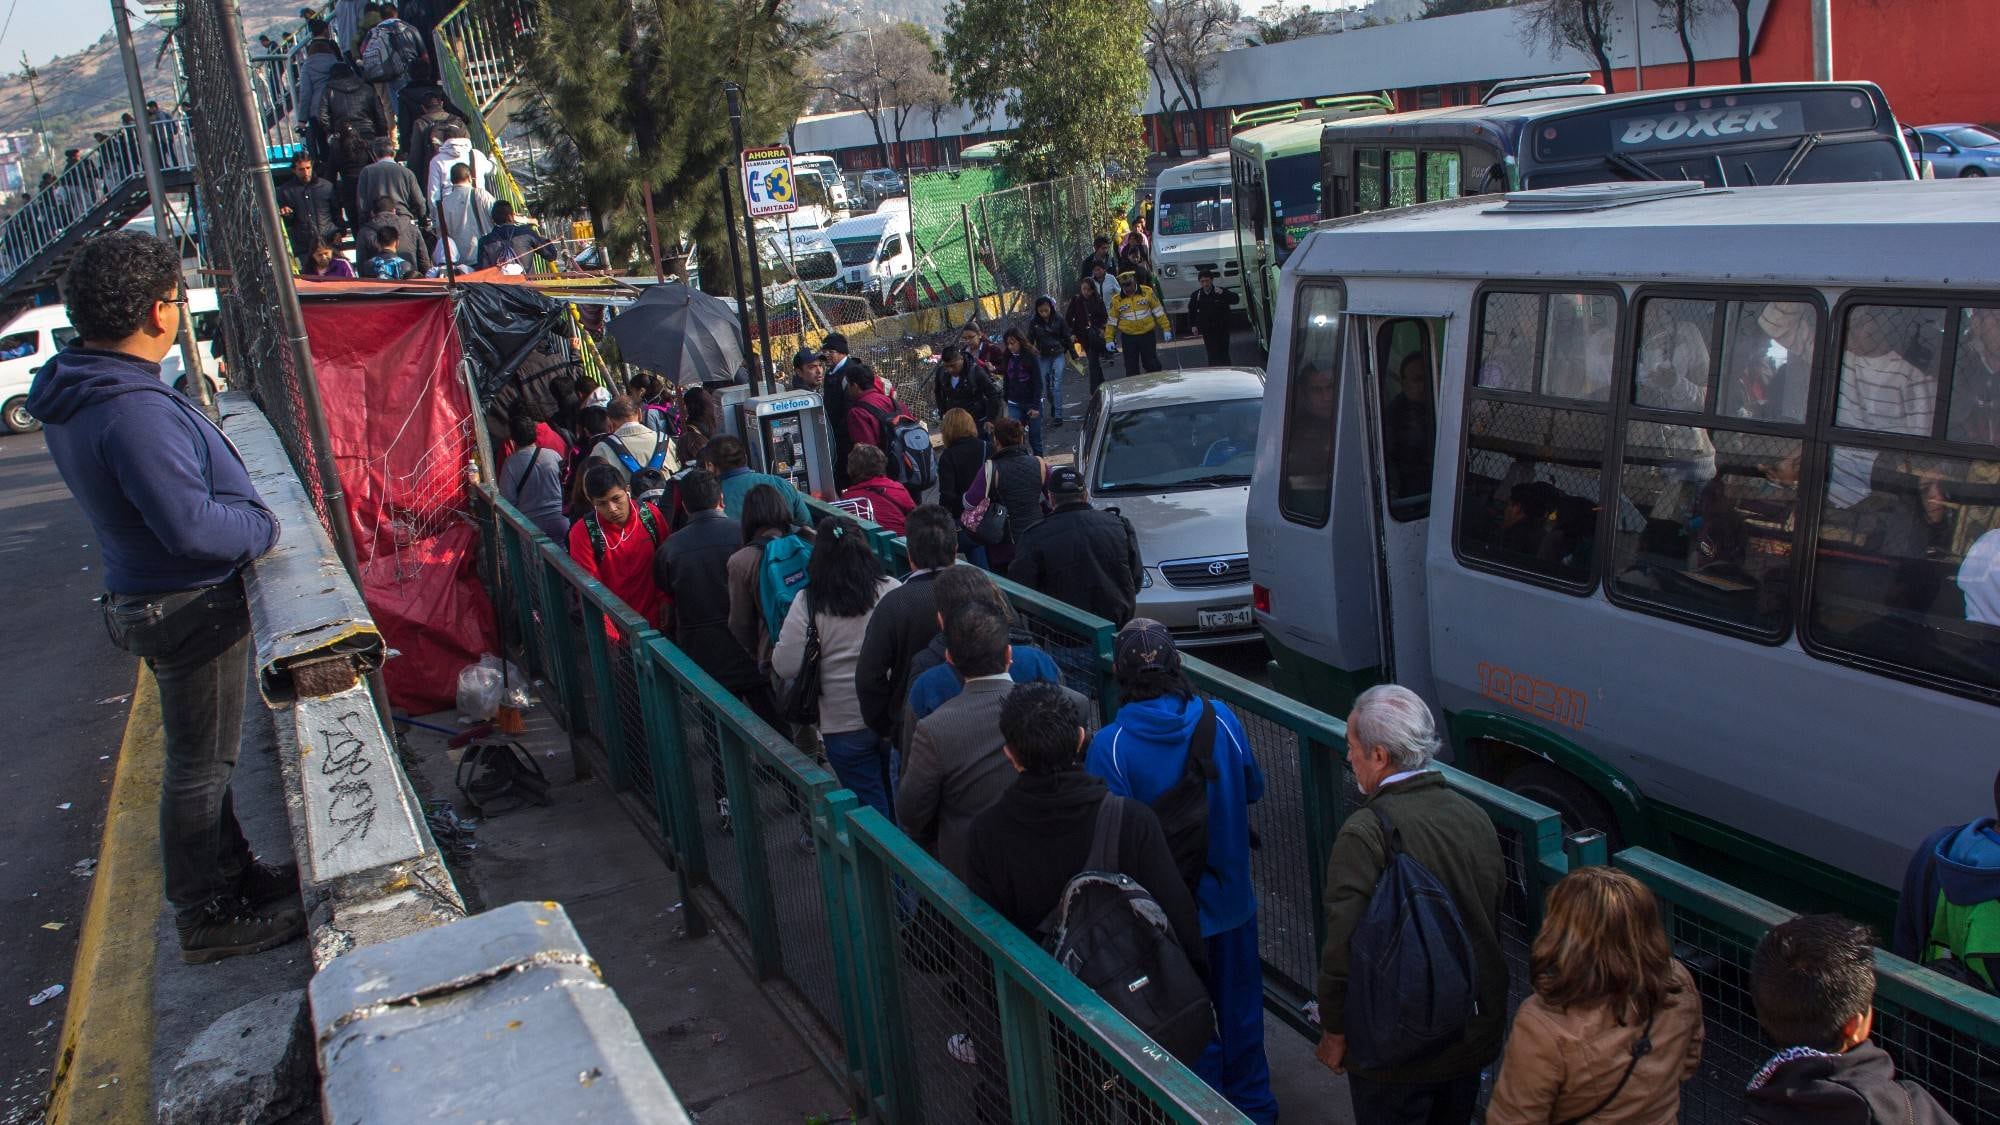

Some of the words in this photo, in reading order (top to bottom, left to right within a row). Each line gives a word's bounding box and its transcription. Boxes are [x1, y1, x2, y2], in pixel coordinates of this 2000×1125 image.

[1620, 105, 1783, 144] BOXER
[748, 149, 787, 160] AHORRA
[746, 160, 772, 168] LLAMADA
[752, 203, 795, 214] ILIMITADA
[1200, 610, 1249, 627] LYC-30-41
